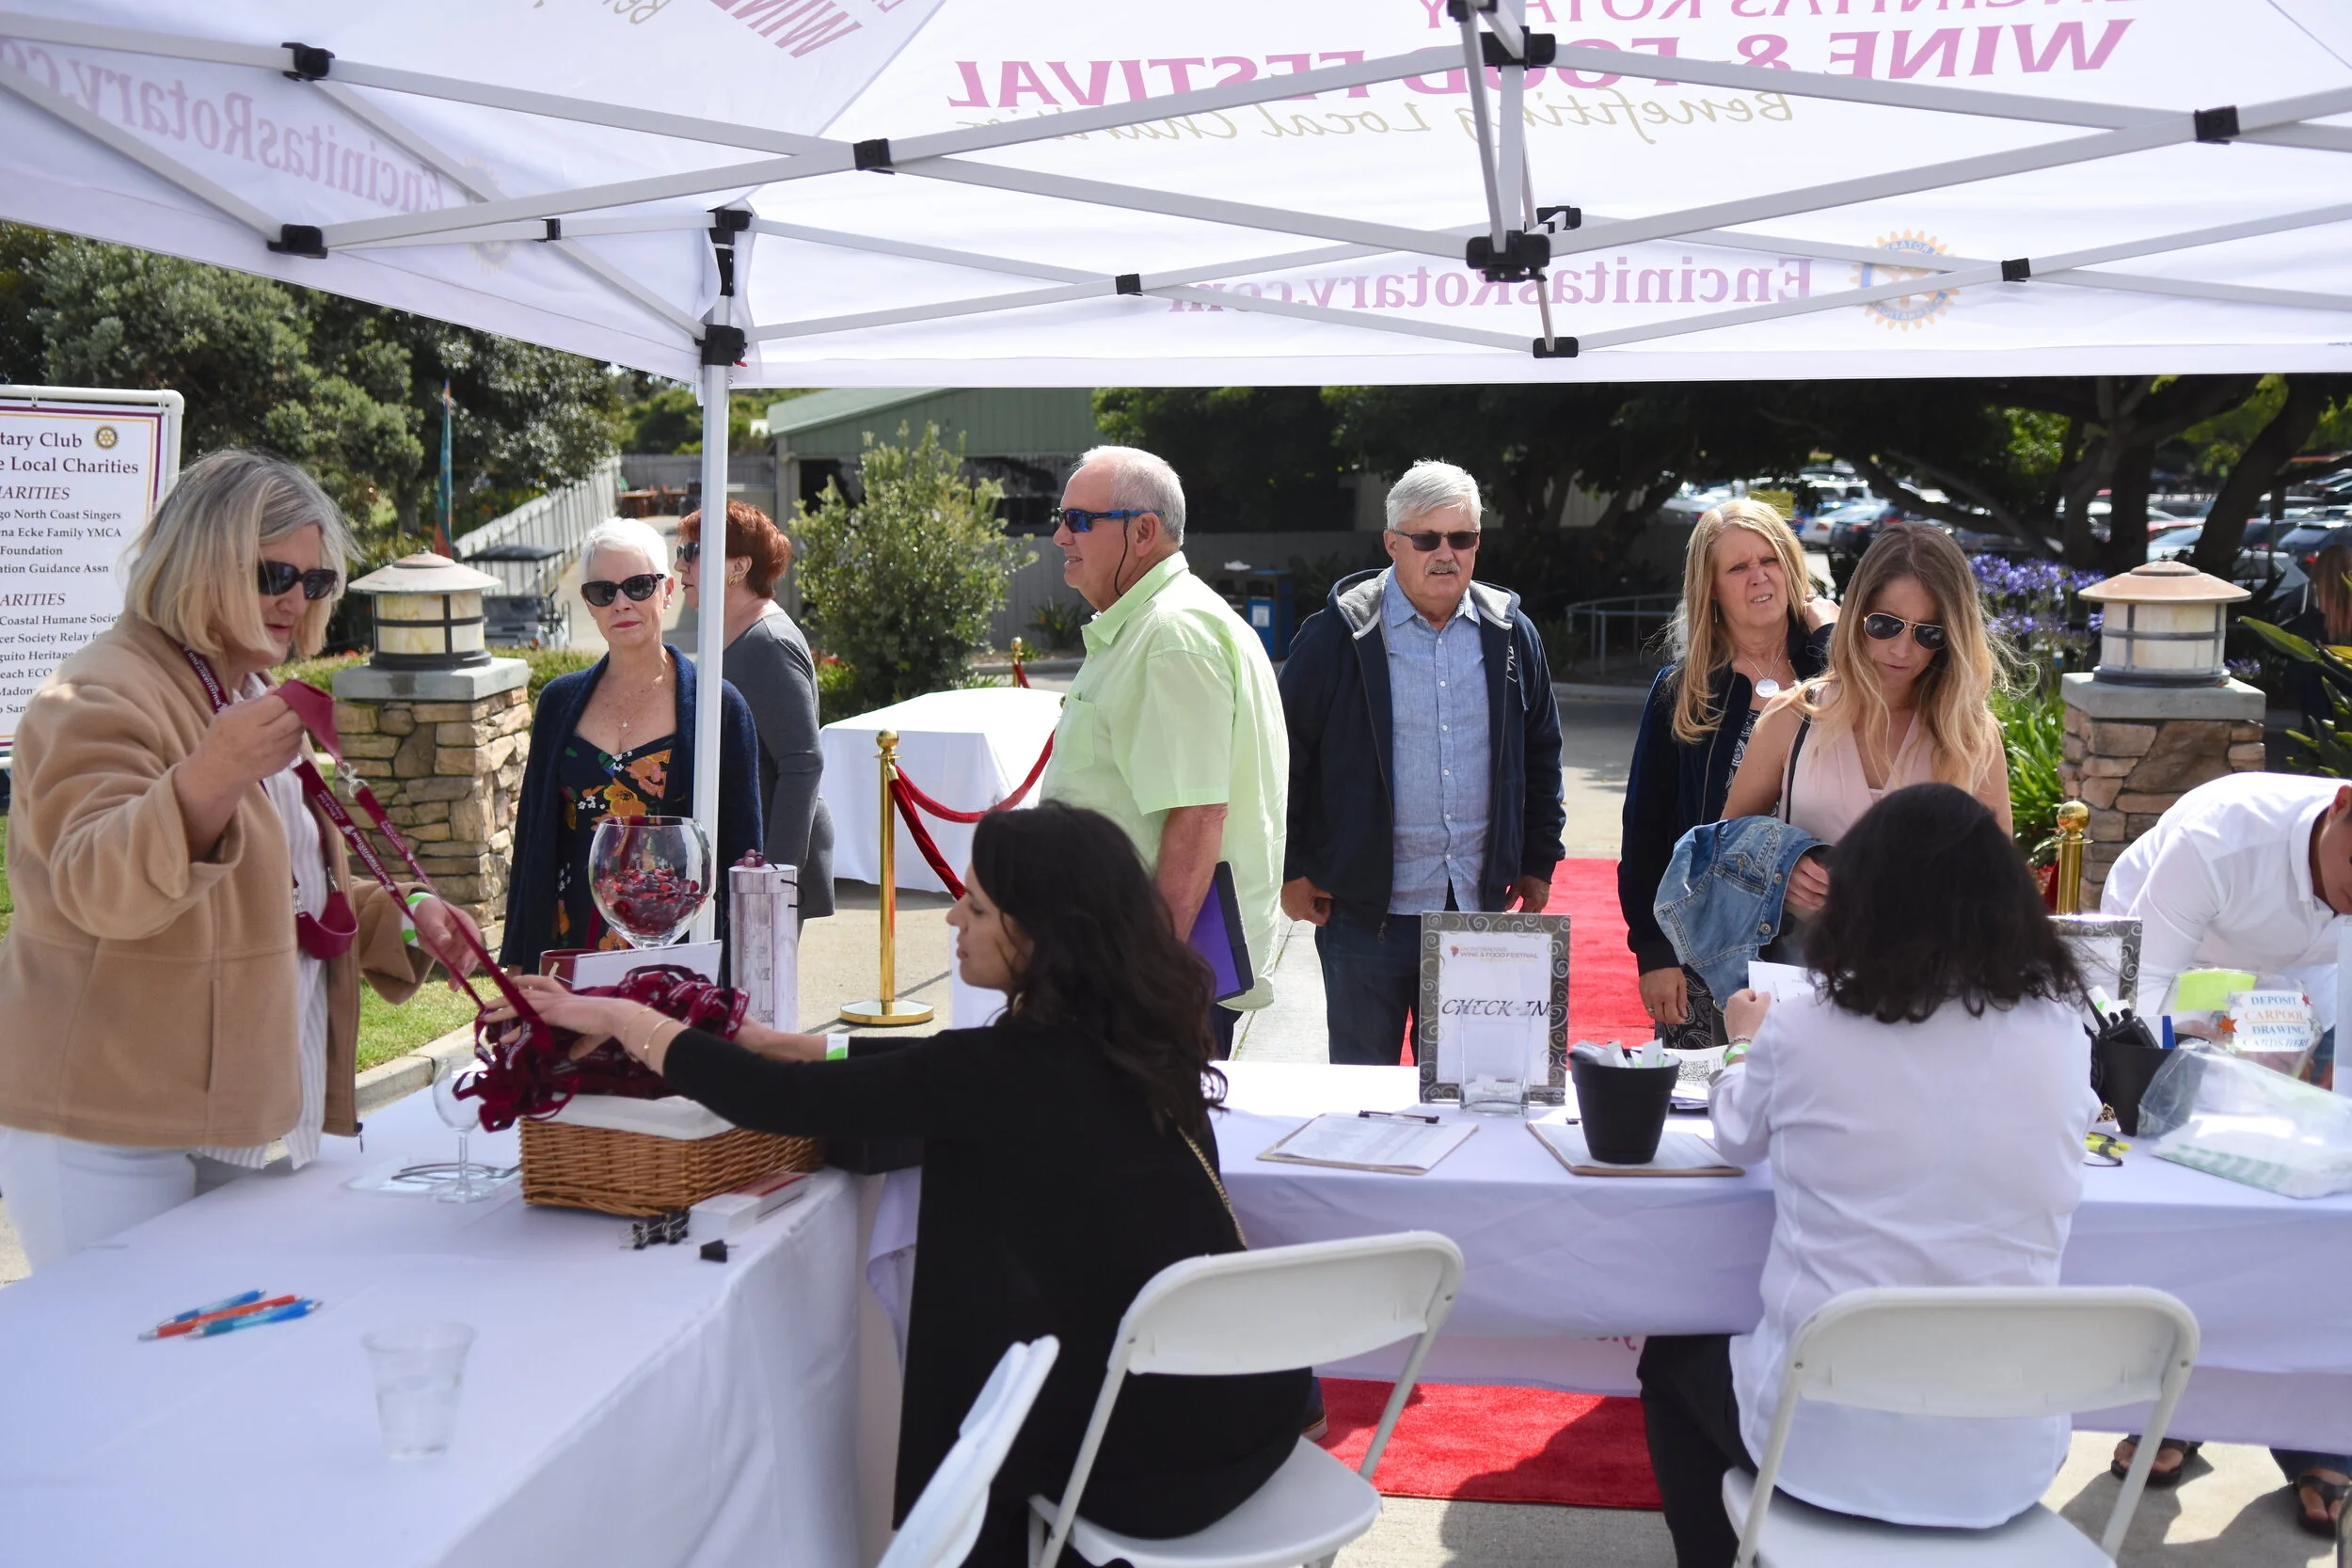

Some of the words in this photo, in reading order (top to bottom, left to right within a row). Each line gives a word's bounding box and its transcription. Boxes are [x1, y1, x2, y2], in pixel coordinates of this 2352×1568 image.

[40, 433, 82, 448] Club
[10, 456, 56, 472] Local
[62, 458, 138, 474] Charities
[14, 509, 46, 519] North
[50, 509, 79, 519] Coast
[83, 511, 121, 522] Singers
[19, 527, 43, 537] Ecke
[47, 528, 84, 540] Family
[87, 529, 121, 537] YMCA
[0, 546, 63, 555] Foundation
[29, 563, 81, 574] Guidance
[84, 564, 109, 573] Assn
[0, 615, 39, 626] Coastal
[42, 614, 87, 625] Humane
[18, 633, 56, 645] Society
[60, 632, 89, 644] Relay
[2250, 995, 2296, 1006] DEPOSIT
[2244, 1009, 2306, 1021] CARPOOL
[2252, 1025, 2305, 1035] DRAWING
